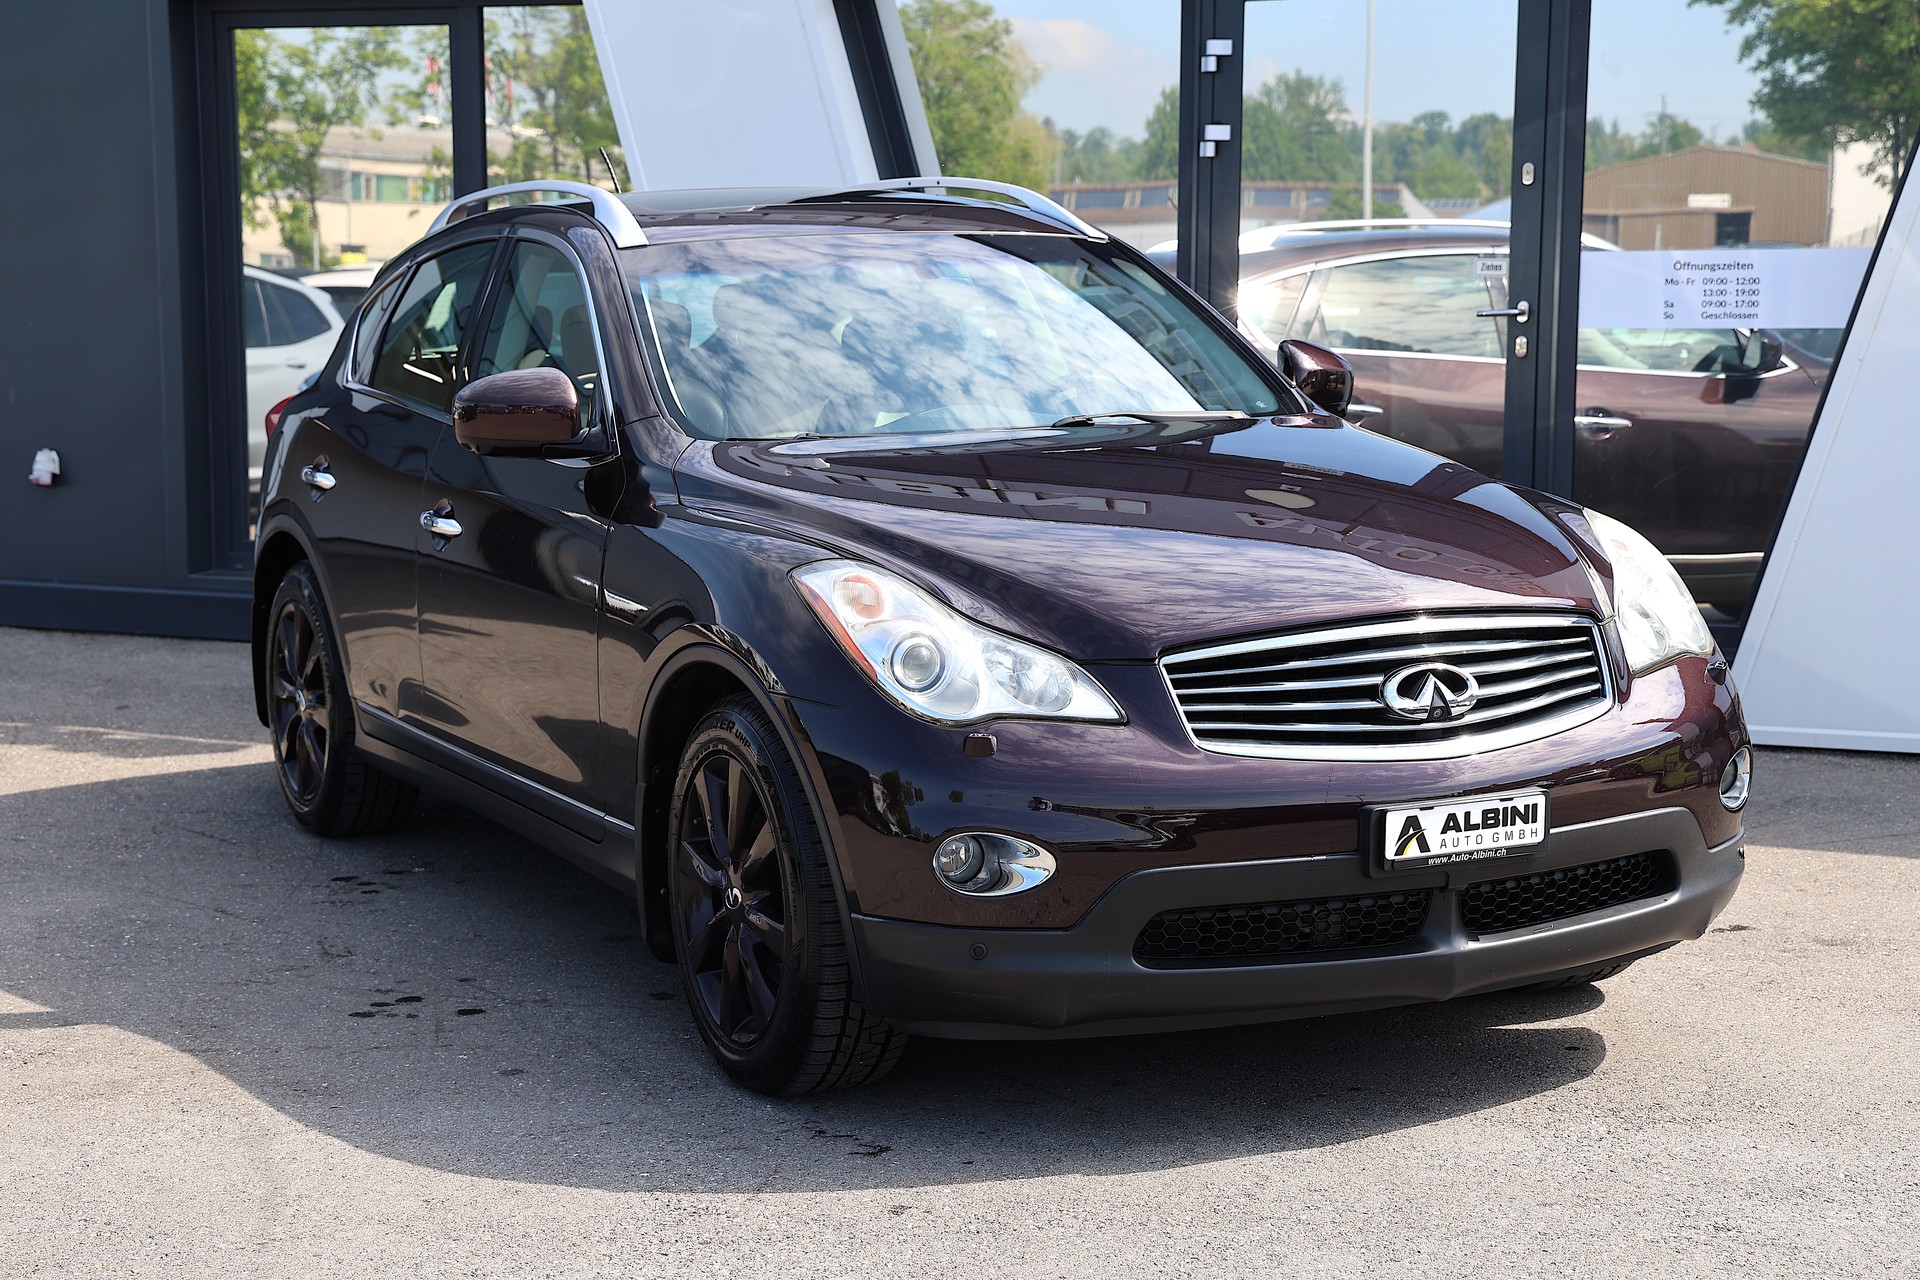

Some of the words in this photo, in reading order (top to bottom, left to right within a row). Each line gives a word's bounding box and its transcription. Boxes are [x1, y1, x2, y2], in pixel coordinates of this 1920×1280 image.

[1673, 260, 1754, 272] Öffnungszeiten
[1665, 277, 1679, 286] Mo
[1686, 277, 1695, 286] Fr
[1702, 277, 1728, 286] 09:00
[1736, 277, 1761, 286] 12:00
[1703, 288, 1728, 297] 13:00
[1735, 288, 1760, 297] 19:00
[1663, 300, 1674, 309] Sa
[1701, 300, 1727, 309] 09:00
[1735, 300, 1760, 309] 17:00
[1663, 312, 1675, 320] So
[1700, 311, 1759, 320] Geschlossen
[1440, 803, 1538, 835] ALBINI
[1440, 834, 1483, 849] AUTO
[1492, 828, 1538, 843] GMBH
[1428, 848, 1507, 866] www.Auto-Albini.ch
